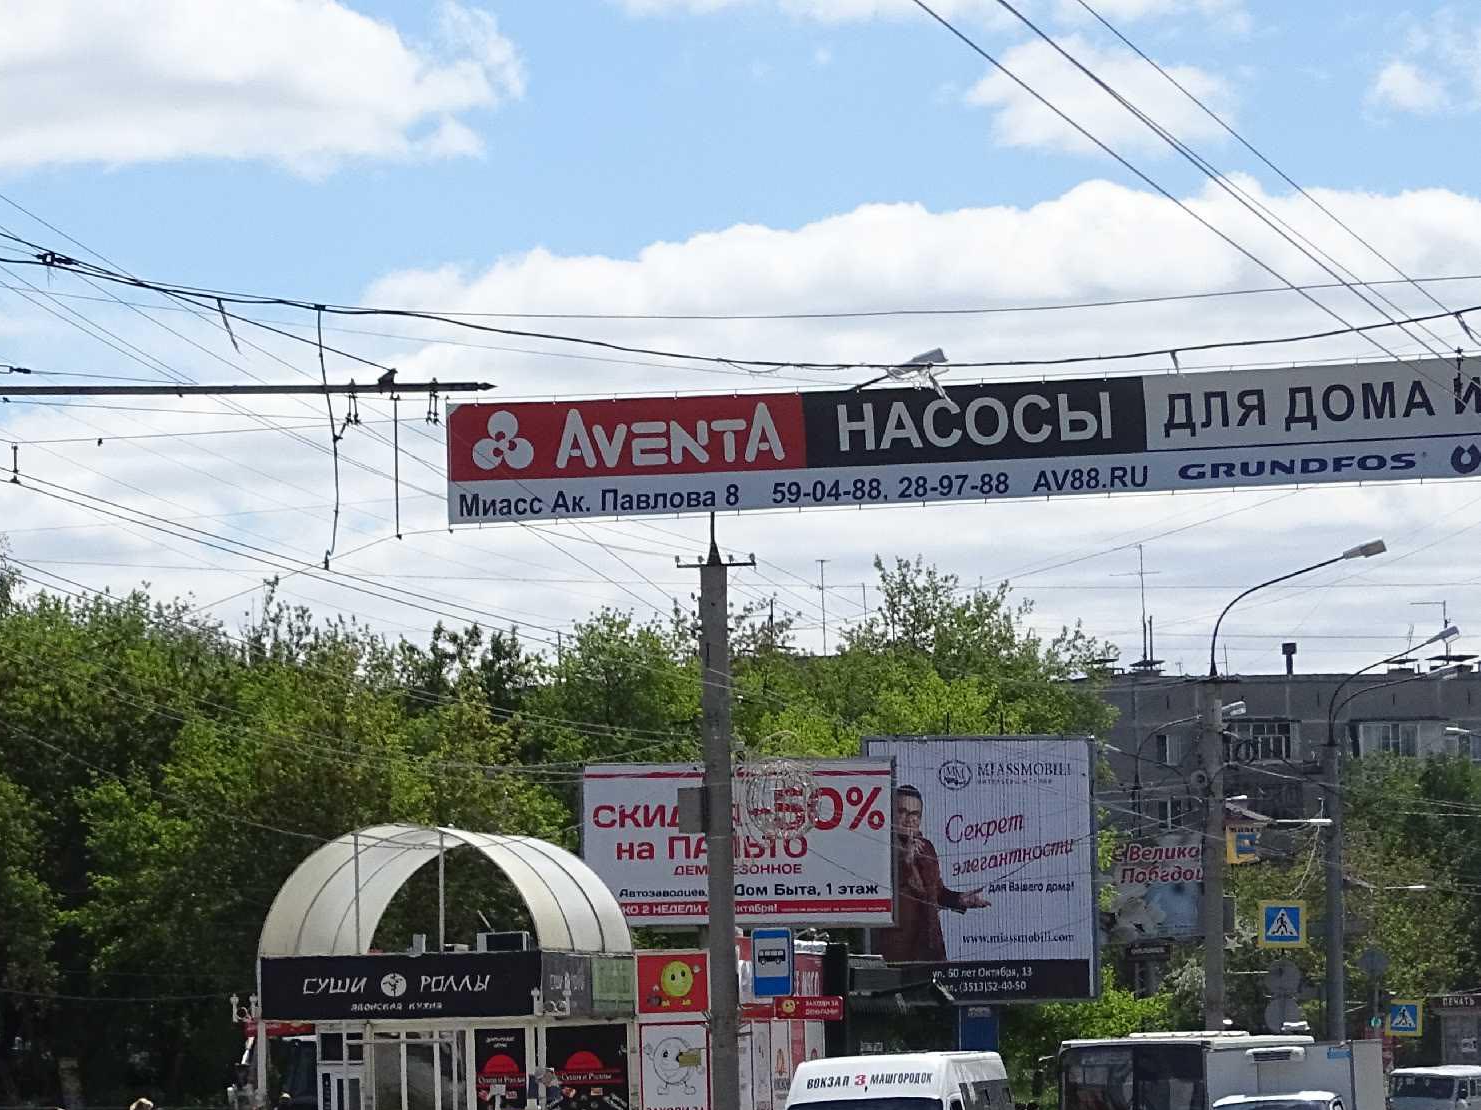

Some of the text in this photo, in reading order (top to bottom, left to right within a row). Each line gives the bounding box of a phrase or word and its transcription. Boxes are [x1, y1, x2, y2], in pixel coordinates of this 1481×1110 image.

[1164, 387, 1266, 439] ДЛЯ
[1285, 379, 1436, 431] ДОМА
[836, 391, 1113, 453] НАСОСЫ
[555, 401, 786, 470] AVENTA
[1032, 452, 1417, 493] AV88.RU GRUNDFOS
[897, 471, 1010, 500] 28-97-88
[459, 483, 741, 518] Миасс Ак. Павлова 8
[945, 814, 1024, 845] Секрет
[616, 840, 655, 860] на
[952, 838, 1074, 877] элегантности
[1126, 844, 1200, 863] Велико
[673, 863, 803, 876] ДЕМЕЗОННОЕ
[774, 882, 821, 898] Быта,
[825, 882, 833, 896] 1
[838, 882, 880, 896] этаж
[641, 904, 649, 915] 2
[652, 903, 702, 914] НЕДЕЛИ
[303, 974, 491, 995] СУШИ РОЛЛЫ
[1442, 997, 1476, 1007] ПЕЧАТЬ
[854, 1074, 866, 1086] 3
[869, 1072, 933, 1085] МАШГОРОДОК
